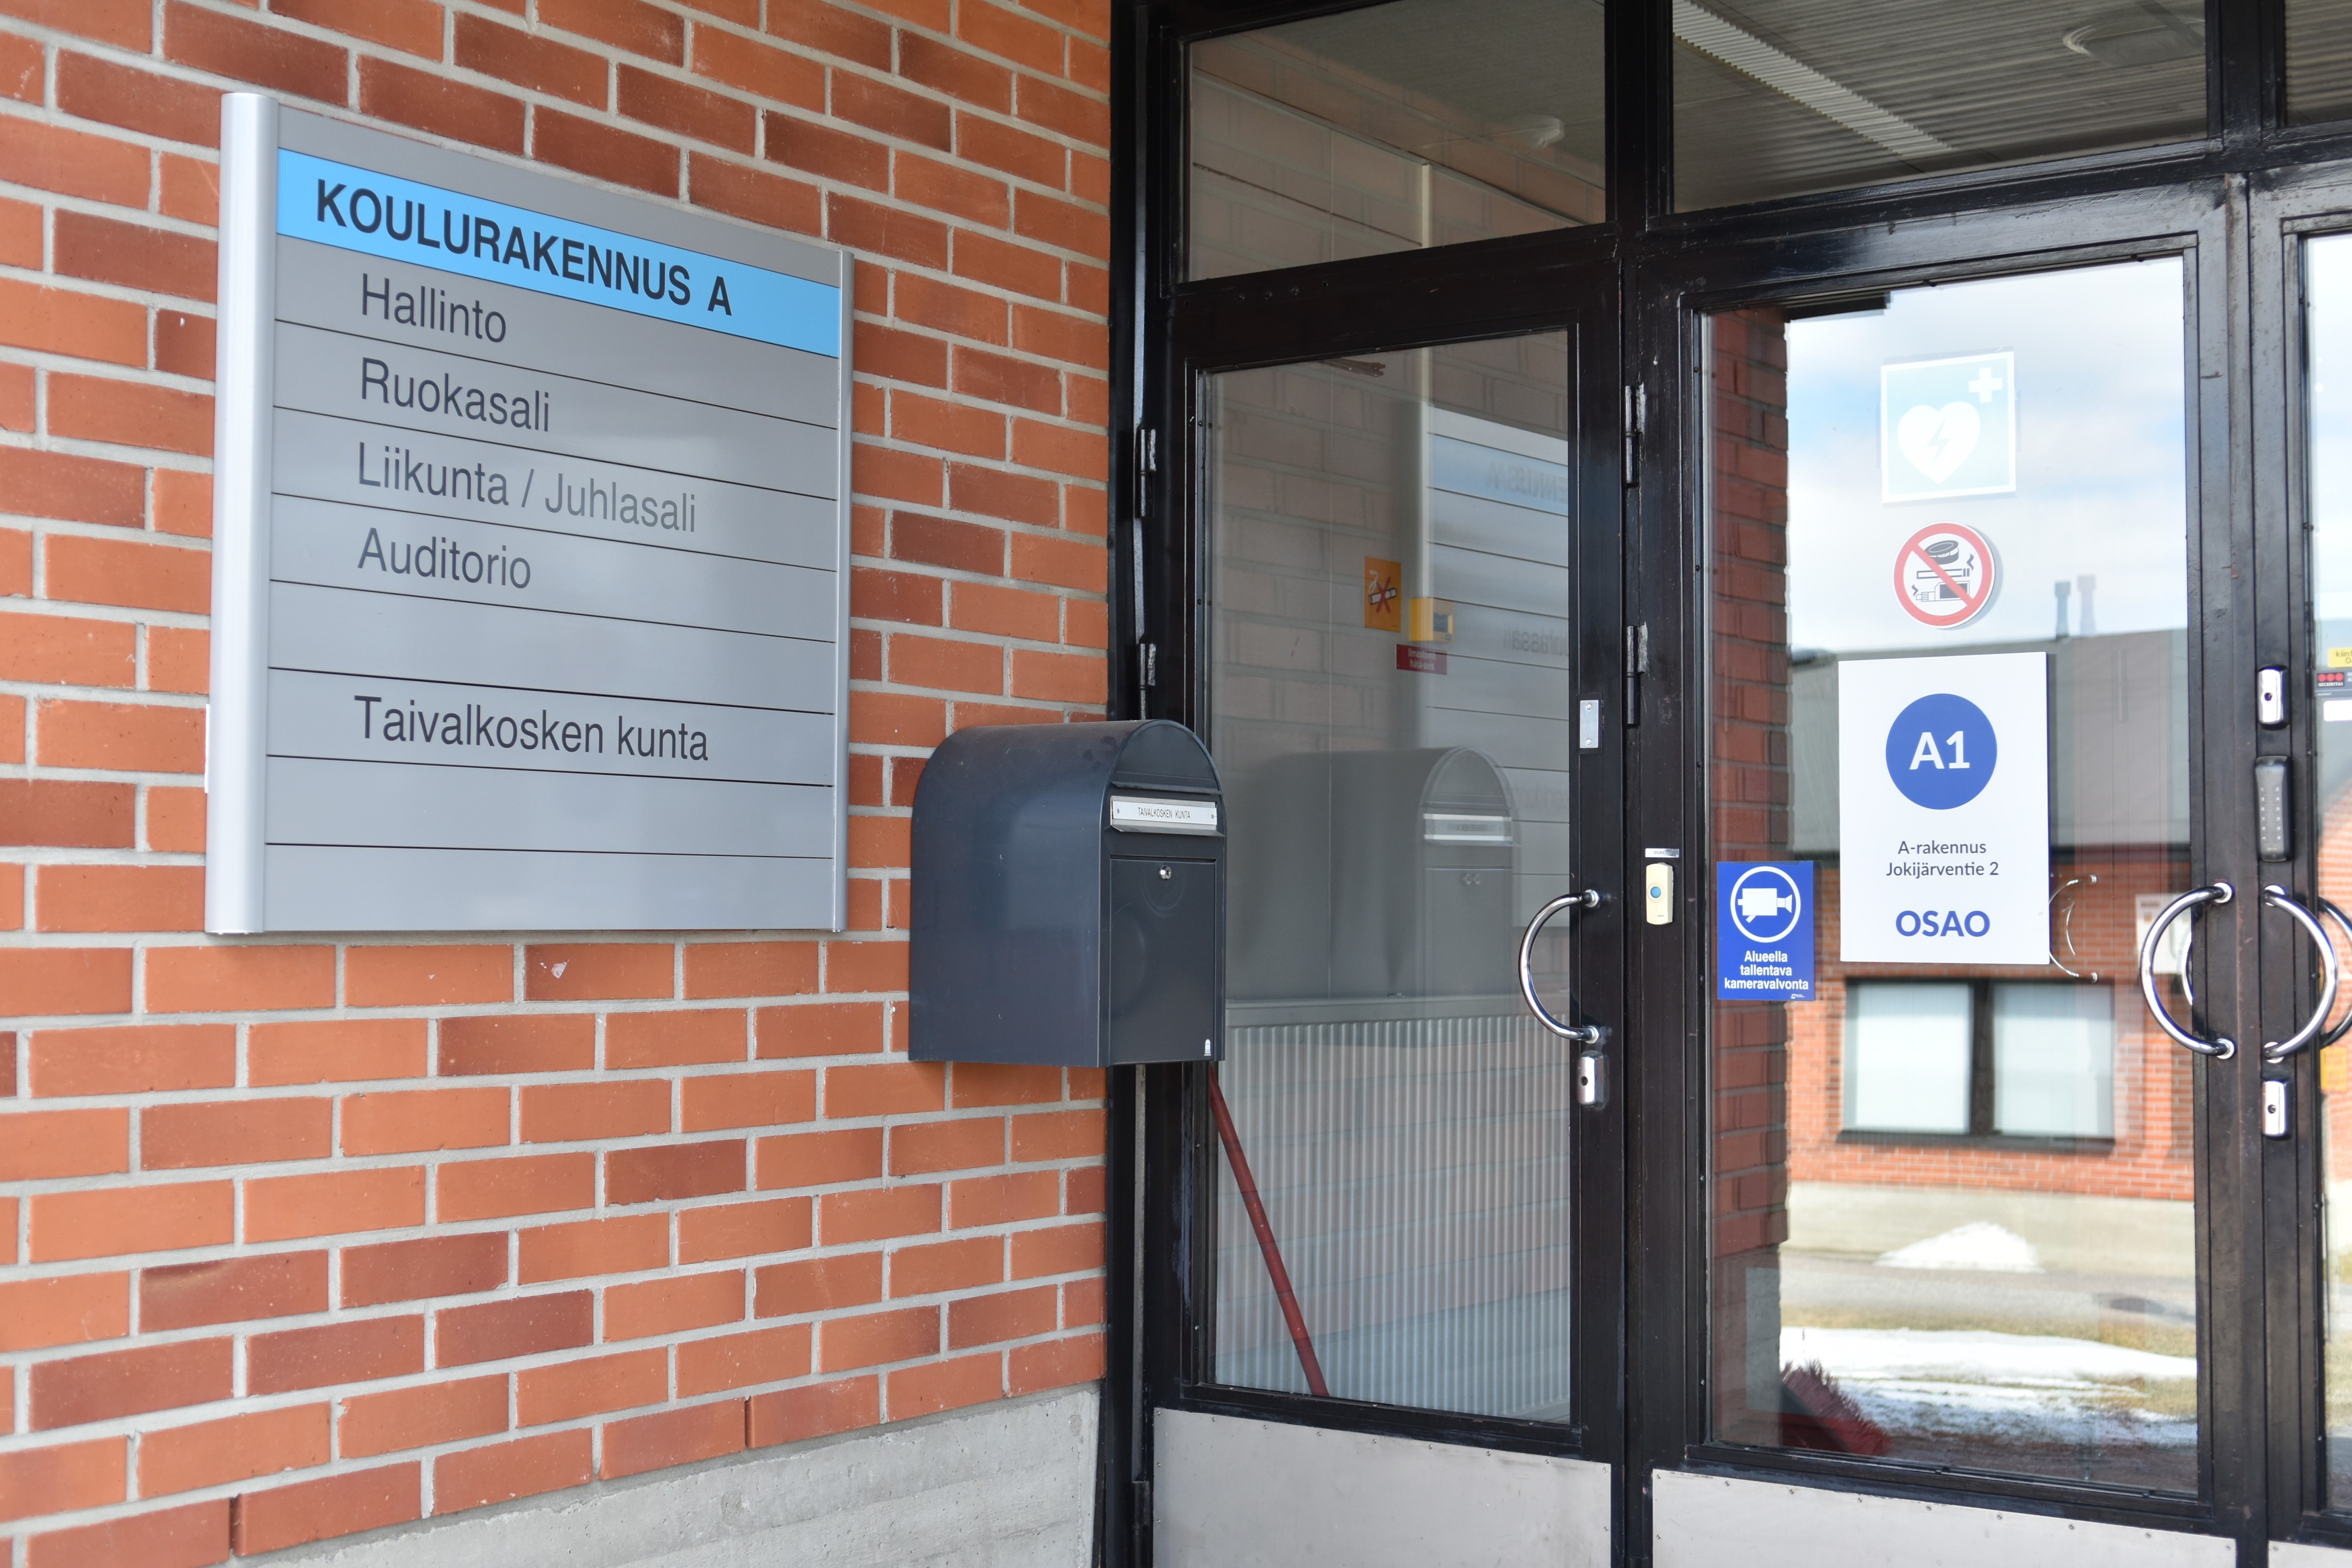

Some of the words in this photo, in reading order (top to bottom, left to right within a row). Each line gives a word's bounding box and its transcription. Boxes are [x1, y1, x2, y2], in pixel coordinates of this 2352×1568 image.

[317, 179, 690, 306] KOULURAKENNUS
[708, 276, 732, 316] A
[362, 273, 506, 343] Hallinto
[362, 357, 548, 432] Ruokasali
[359, 442, 509, 506] Liikunta
[521, 469, 534, 508] /
[545, 473, 695, 532] Juhlasali
[357, 527, 531, 589] Auditorio
[354, 695, 603, 754] Taivalkosken
[618, 715, 709, 761] kunta
[1910, 731, 1970, 770] A1
[1138, 807, 1173, 818] TAIVALKOSKEN
[1175, 810, 1191, 819] KUNTA
[1898, 840, 1986, 854] A-rakennus
[1886, 861, 1984, 879] Jokijärventie
[1990, 861, 1999, 875] 2
[1896, 910, 1990, 937] OSAO
[1740, 964, 1792, 976] tallentava
[1744, 950, 1788, 962] Alueella
[1724, 977, 1809, 990] kameravalvonta
